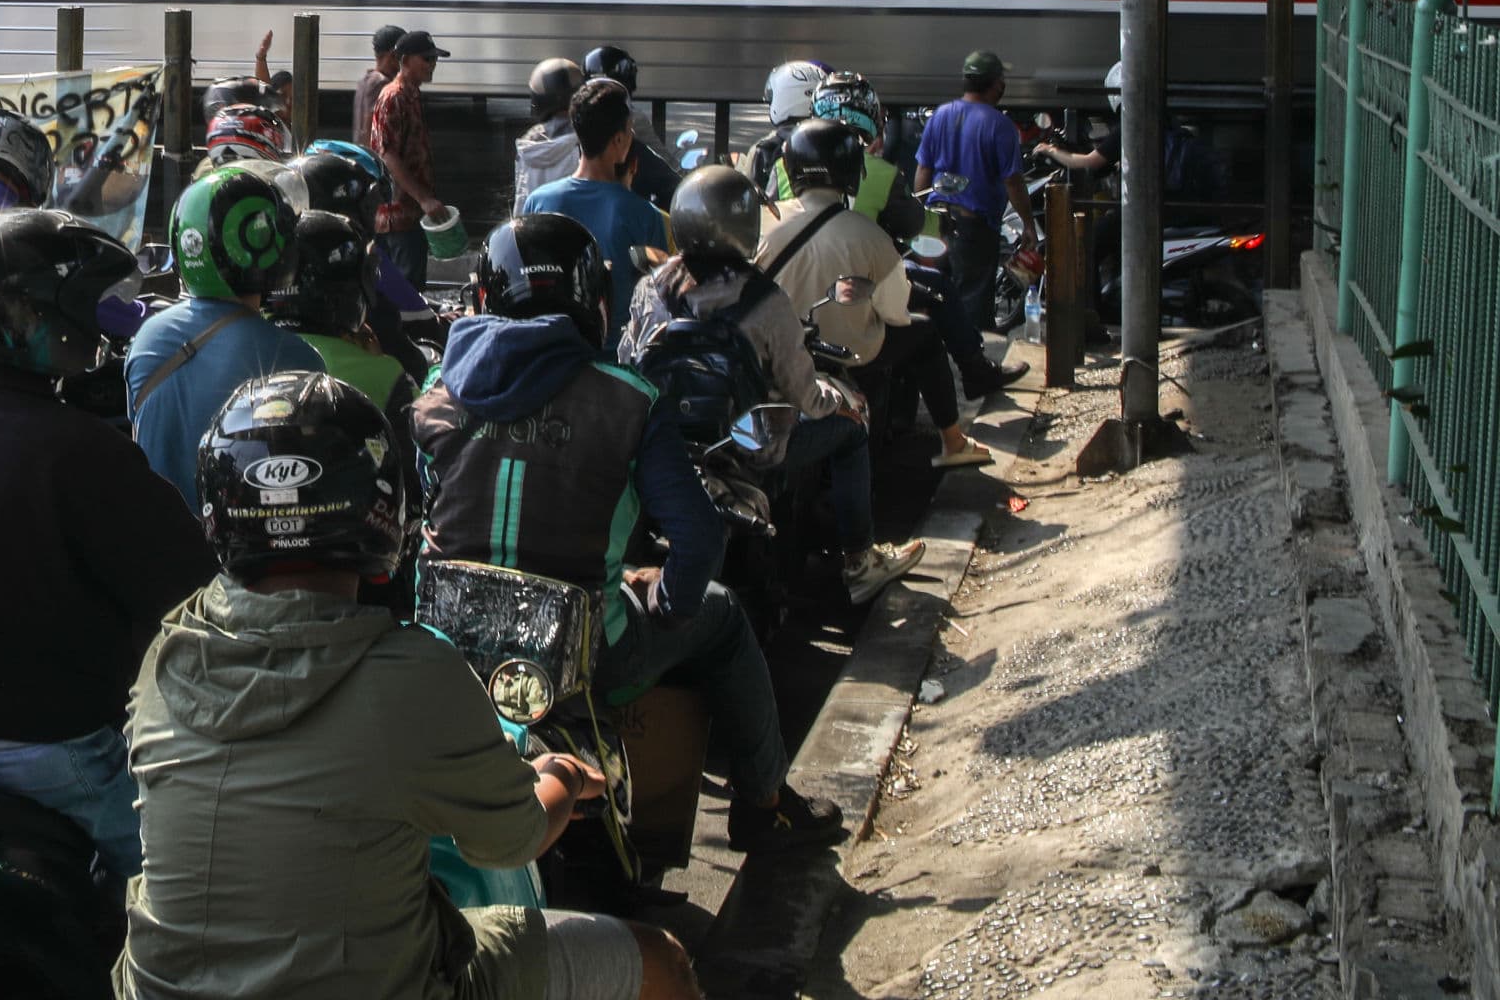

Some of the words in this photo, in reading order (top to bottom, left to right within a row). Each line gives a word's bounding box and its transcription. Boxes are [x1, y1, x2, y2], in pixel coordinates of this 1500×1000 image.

[520, 264, 564, 275] HONDA
[269, 521, 299, 532] DOT
[272, 539, 310, 549] PINLOCK
